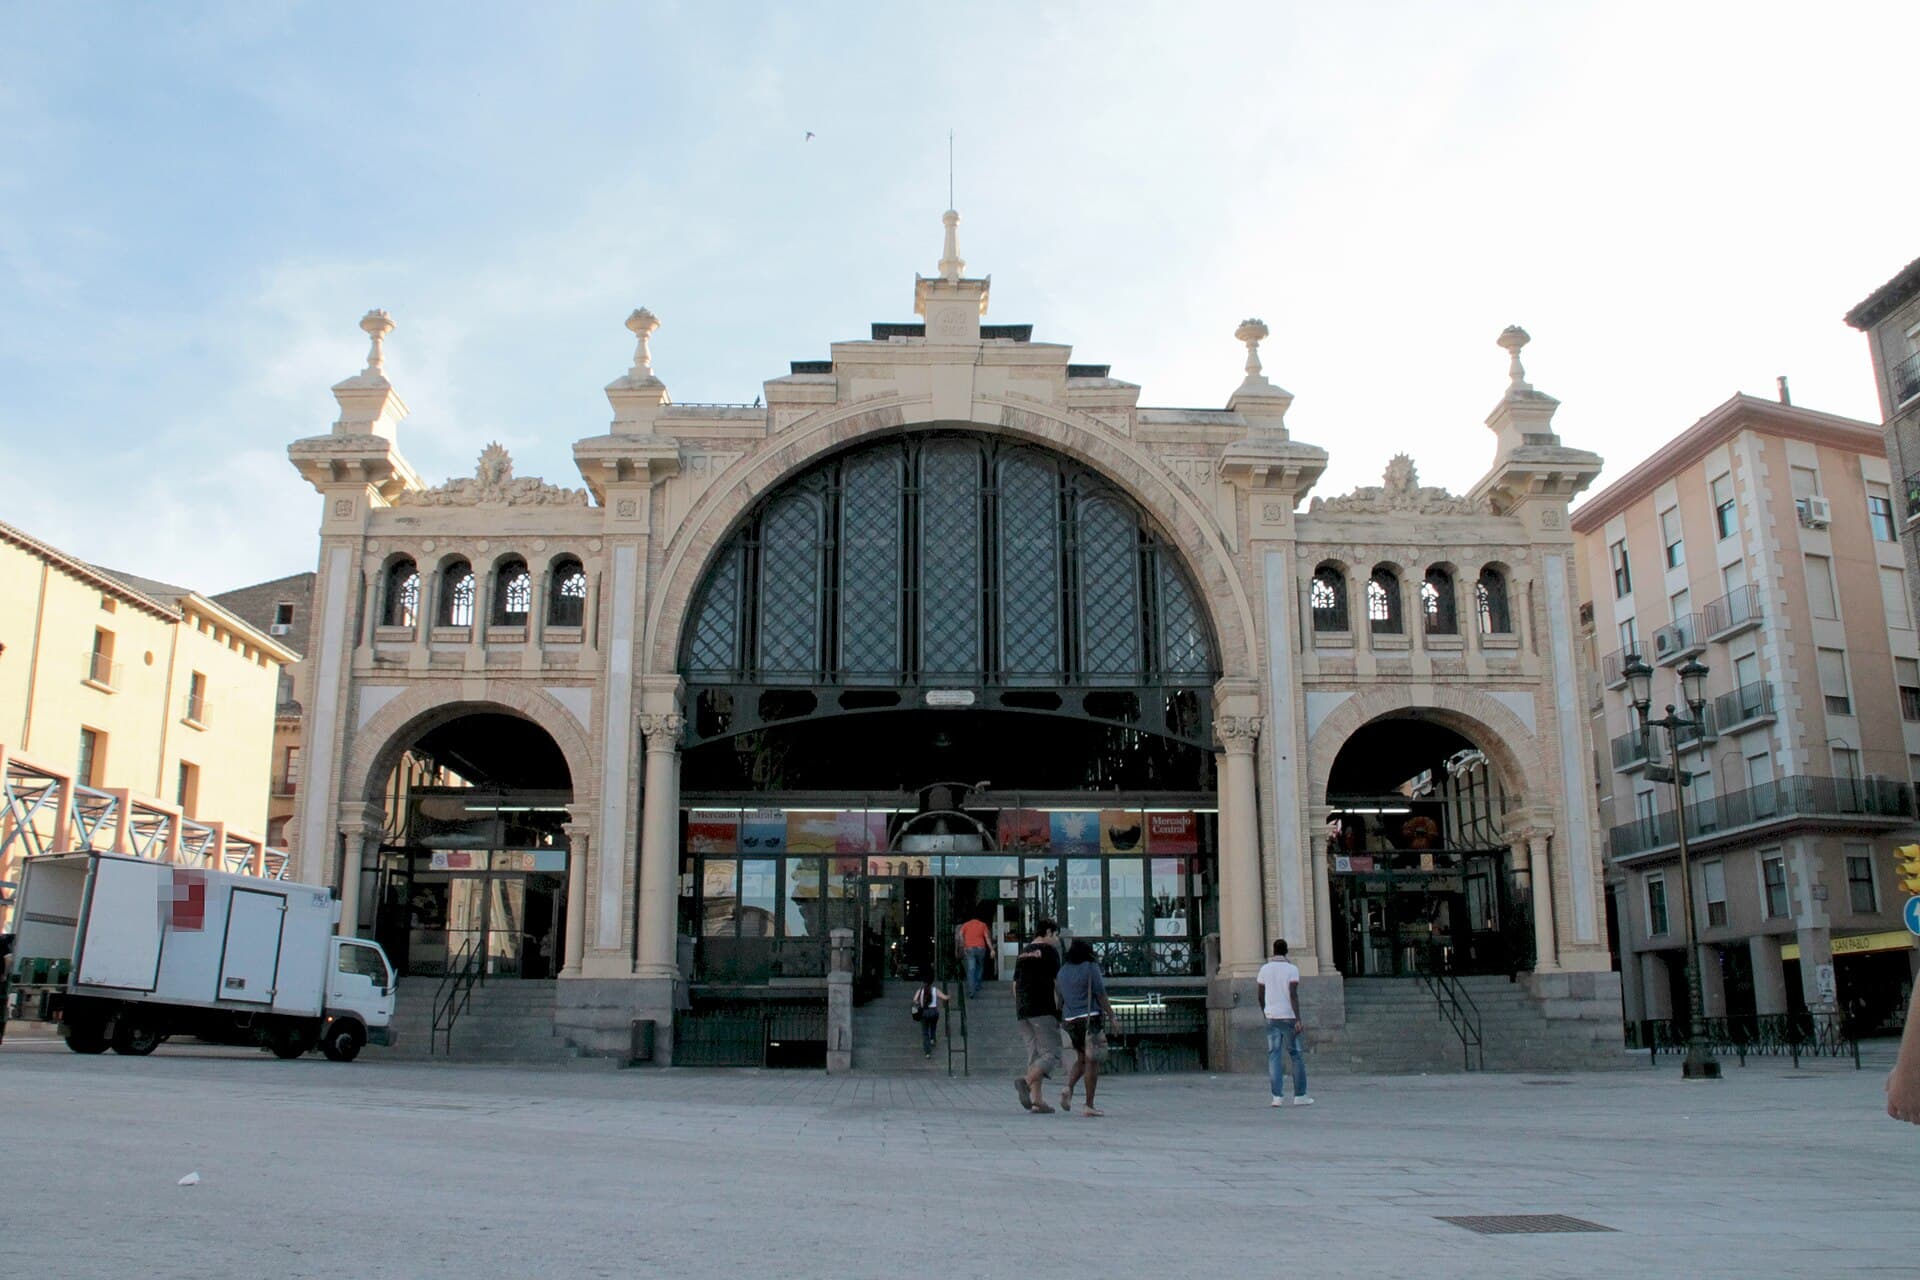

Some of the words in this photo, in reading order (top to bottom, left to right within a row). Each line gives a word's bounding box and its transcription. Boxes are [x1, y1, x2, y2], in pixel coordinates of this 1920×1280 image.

[1152, 815, 1191, 825] Mercado
[1152, 824, 1186, 833] Central
[1834, 940, 1848, 951] SAN
[1849, 937, 1870, 950] PABLO
